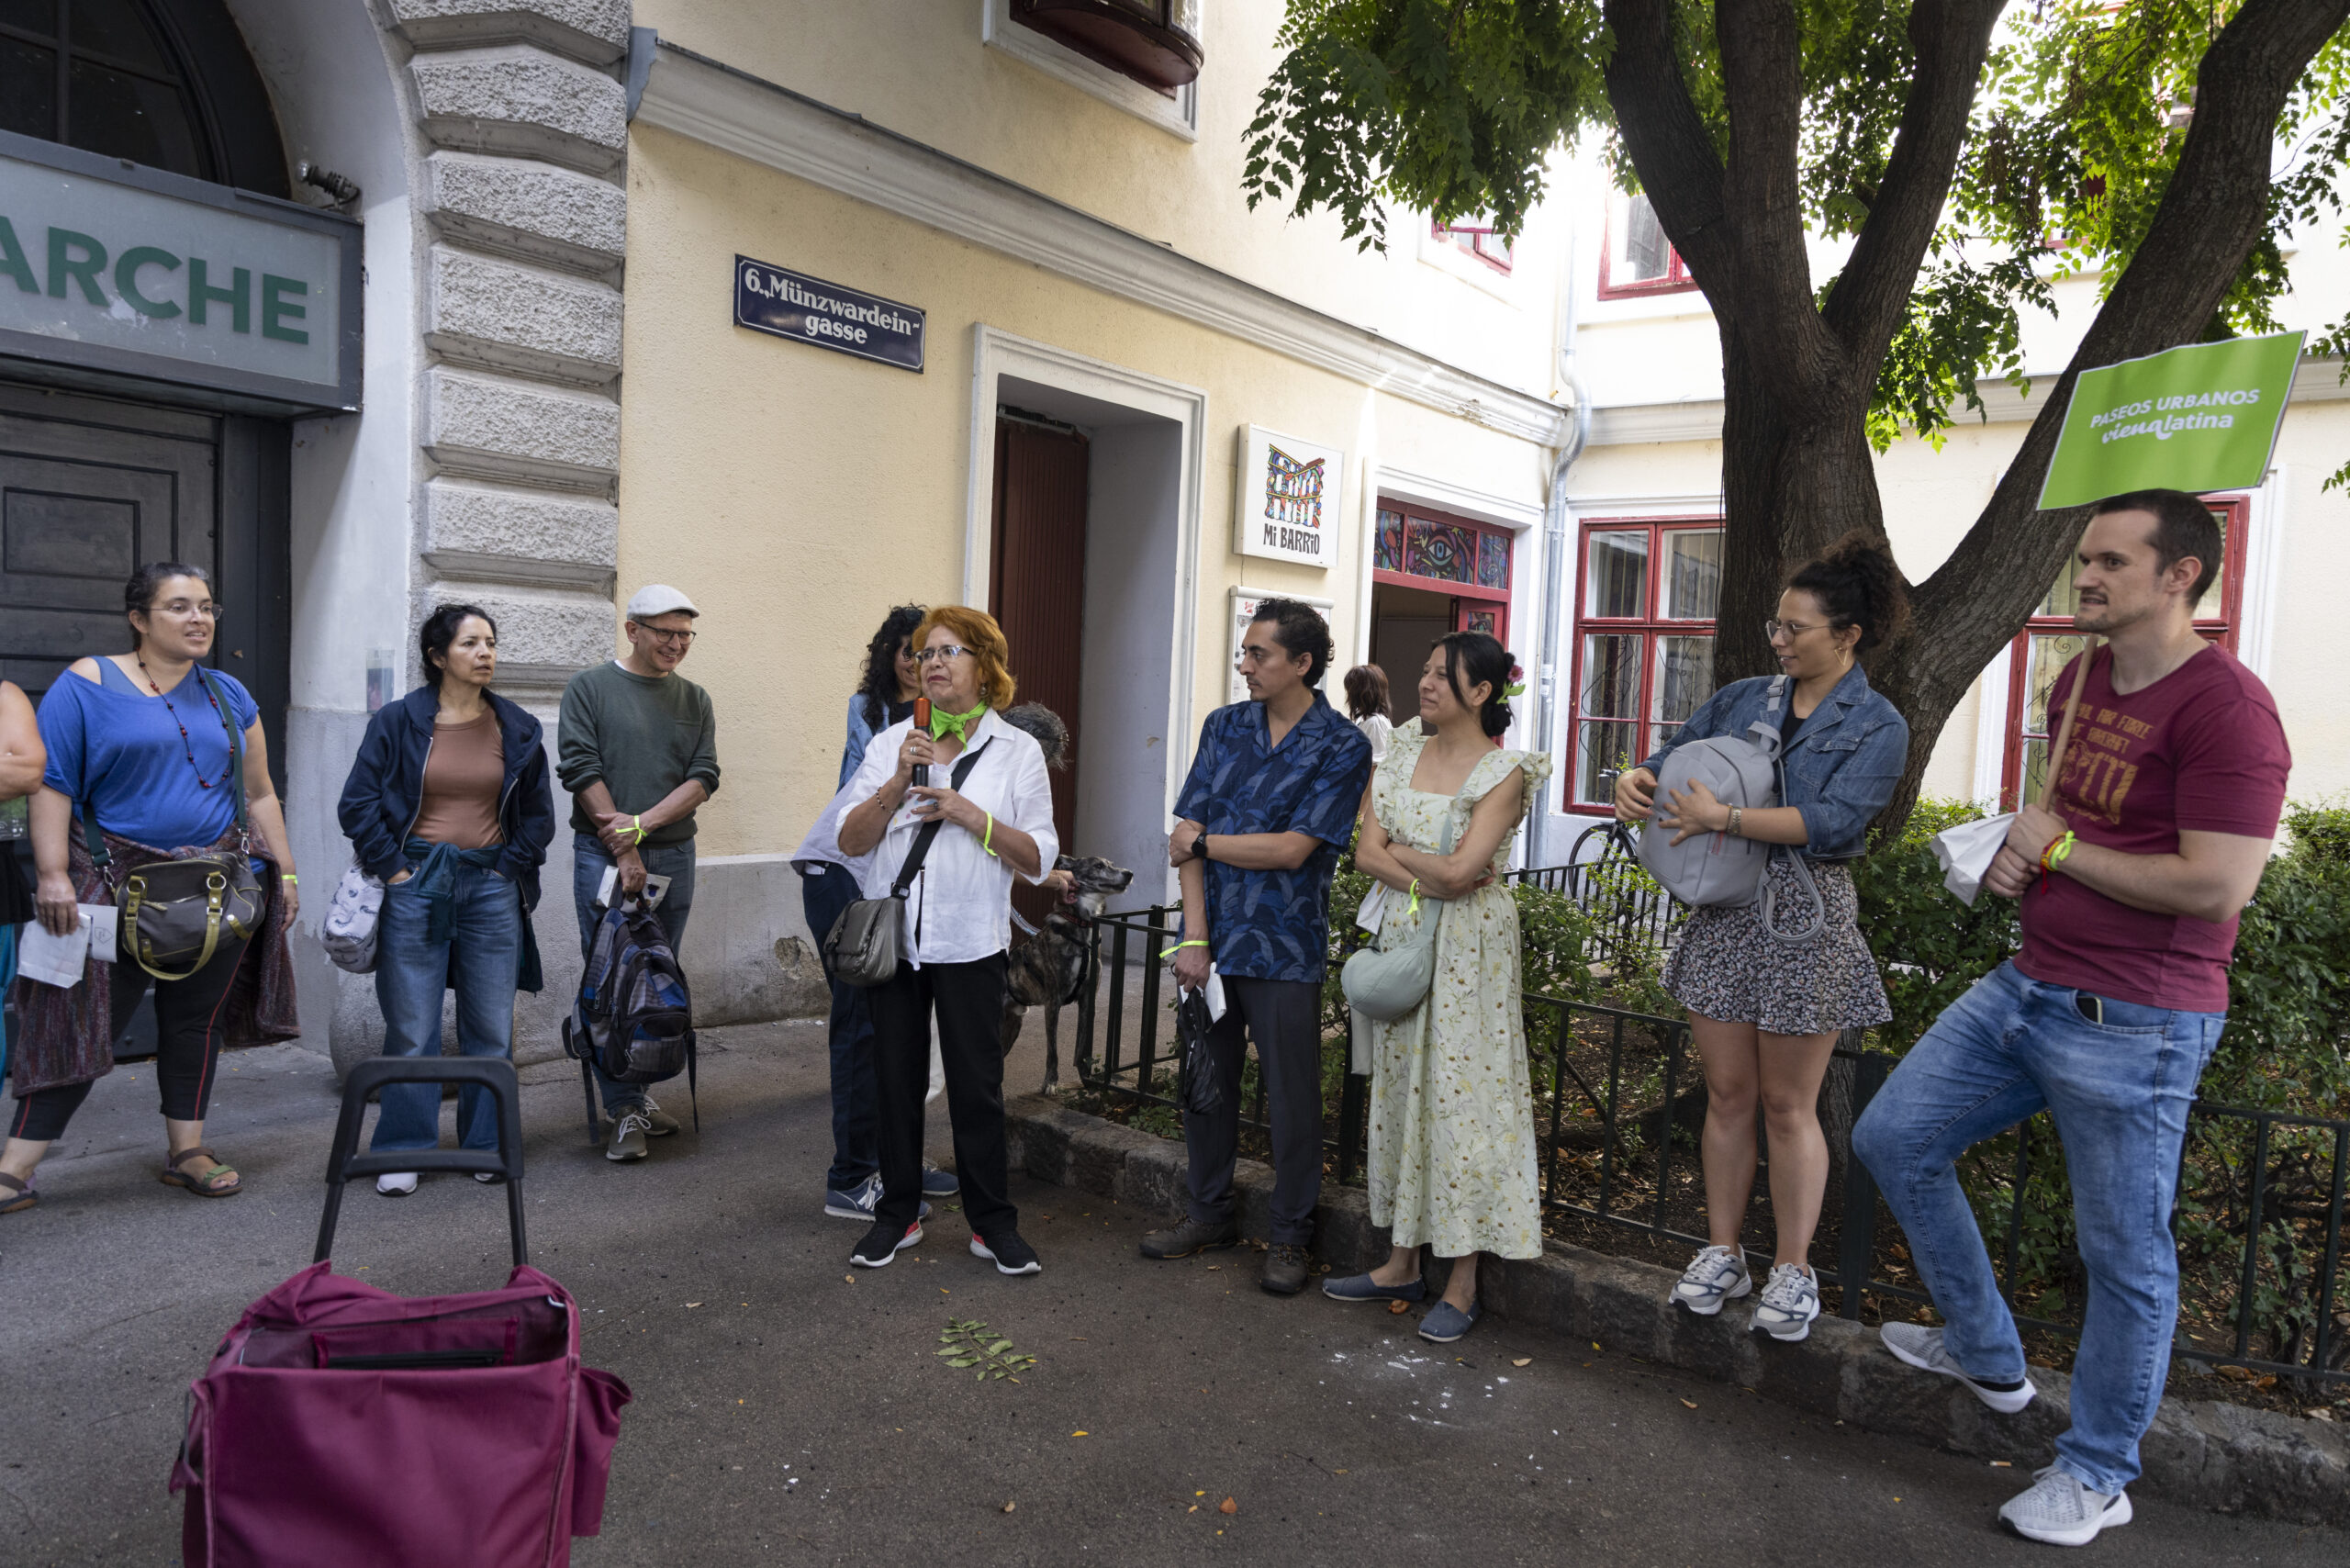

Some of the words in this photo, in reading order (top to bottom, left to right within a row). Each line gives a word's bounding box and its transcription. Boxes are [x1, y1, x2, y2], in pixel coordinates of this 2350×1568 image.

[805, 315, 867, 344] gasse
[2089, 399, 2153, 429] PASEOS
[2156, 388, 2261, 411] URBANOS
